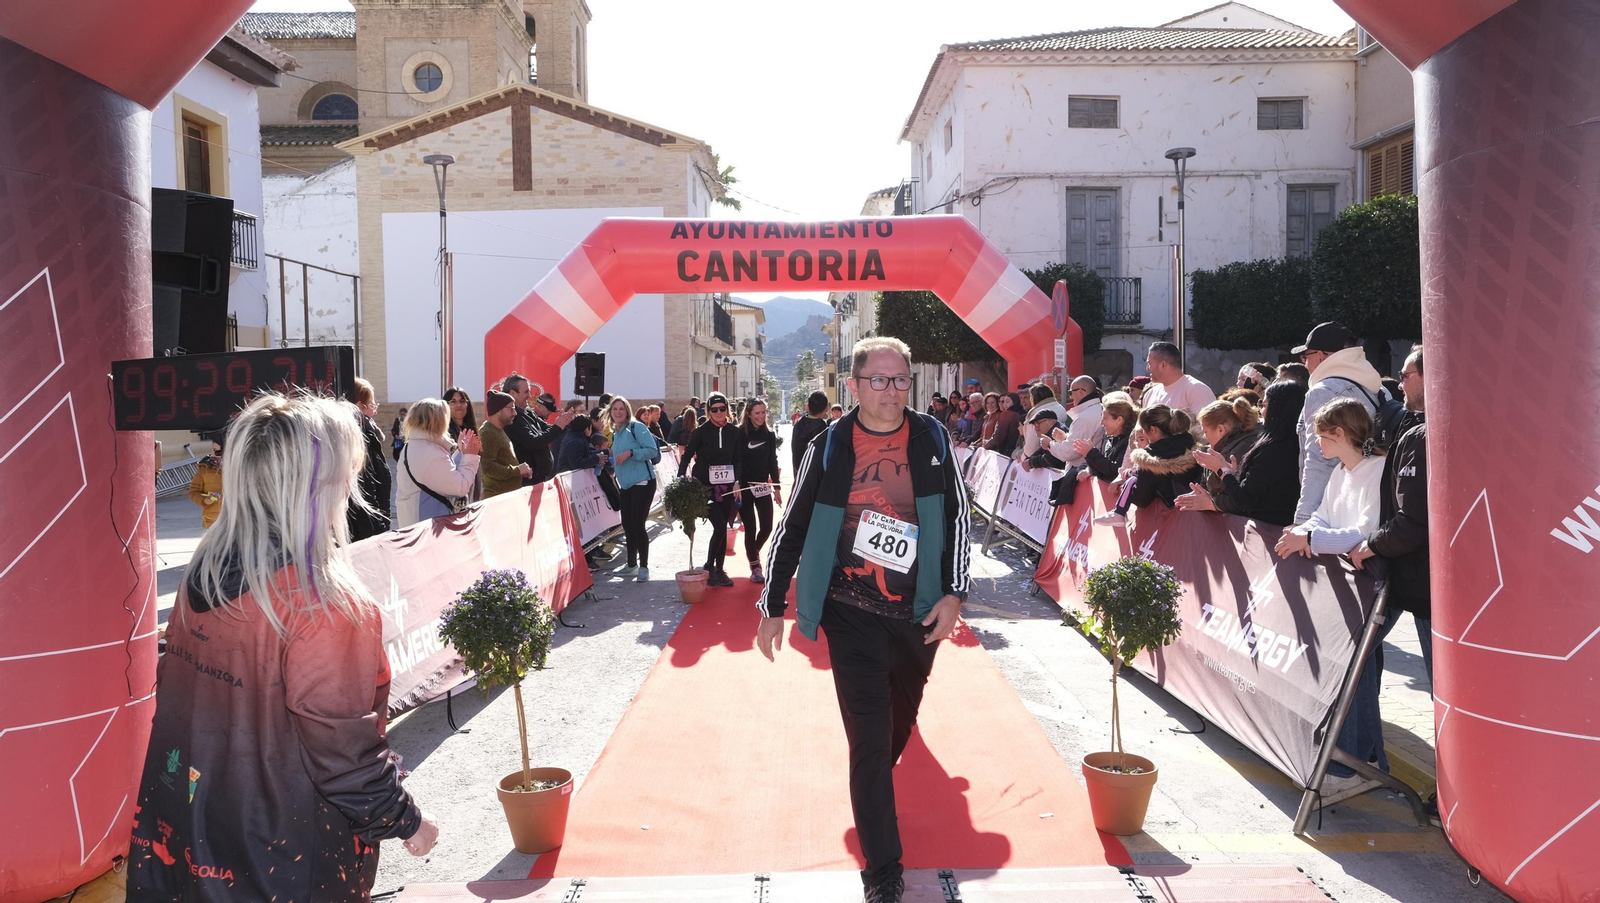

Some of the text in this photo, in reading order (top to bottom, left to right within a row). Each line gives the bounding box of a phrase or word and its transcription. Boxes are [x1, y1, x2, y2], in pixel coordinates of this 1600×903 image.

[670, 220, 893, 240] AYUNTAMIENTO
[677, 249, 886, 282] CANTORIA
[714, 471, 729, 480] 517
[880, 515, 896, 526] CxM
[868, 531, 909, 558] 480
[1195, 602, 1309, 674] TEAMERGY
[189, 864, 234, 881] EOLIA
